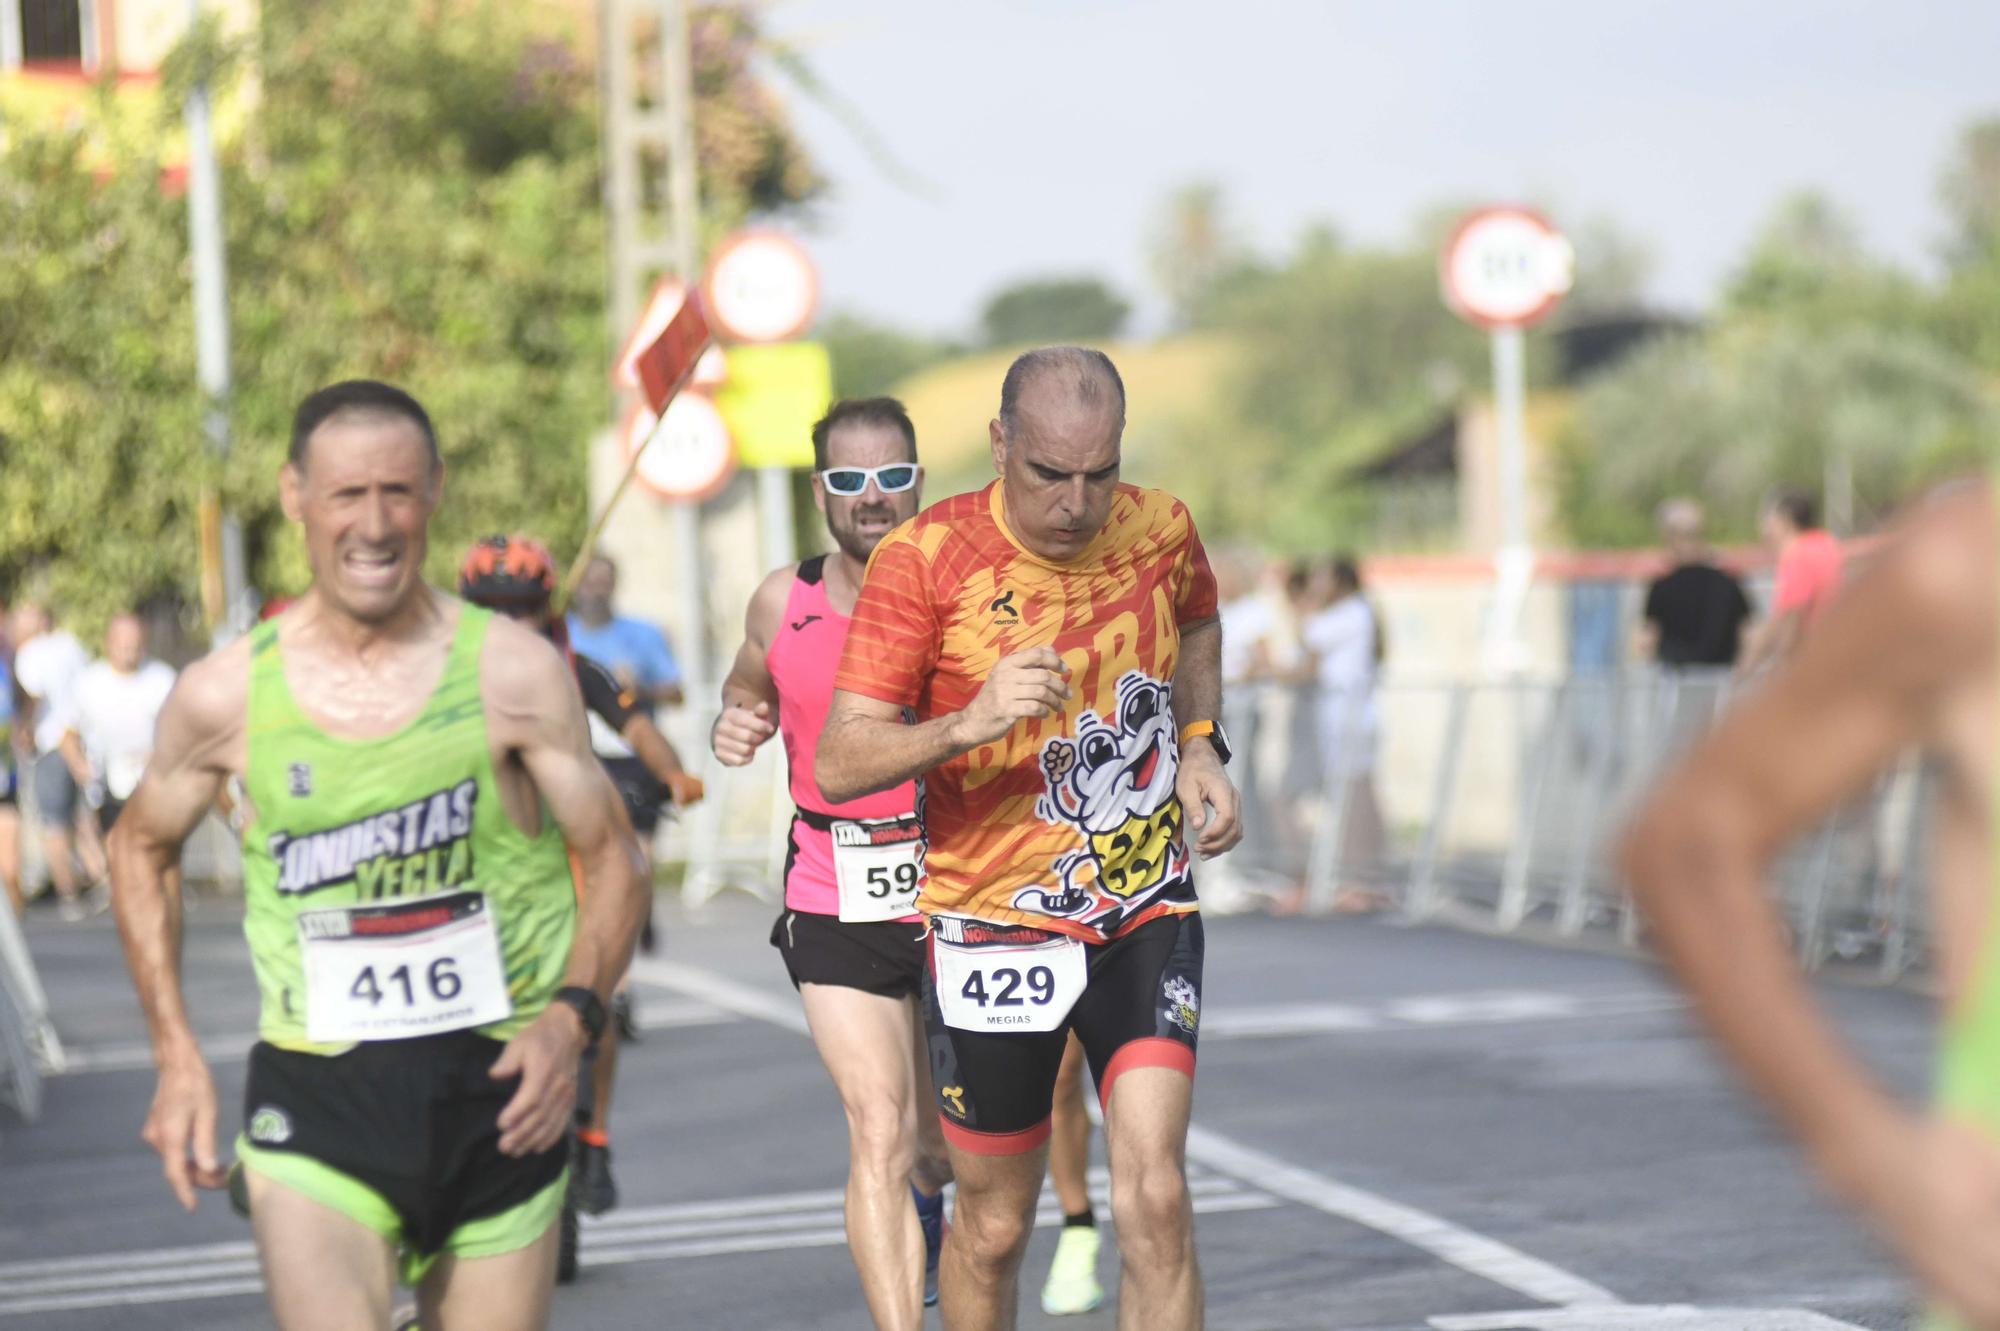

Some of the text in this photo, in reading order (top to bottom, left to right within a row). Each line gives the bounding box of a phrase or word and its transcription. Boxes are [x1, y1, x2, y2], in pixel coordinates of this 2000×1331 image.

[349, 957, 463, 1007] 416
[961, 965, 1055, 1008] 429
[987, 1015, 1031, 1025] MEGIAS
